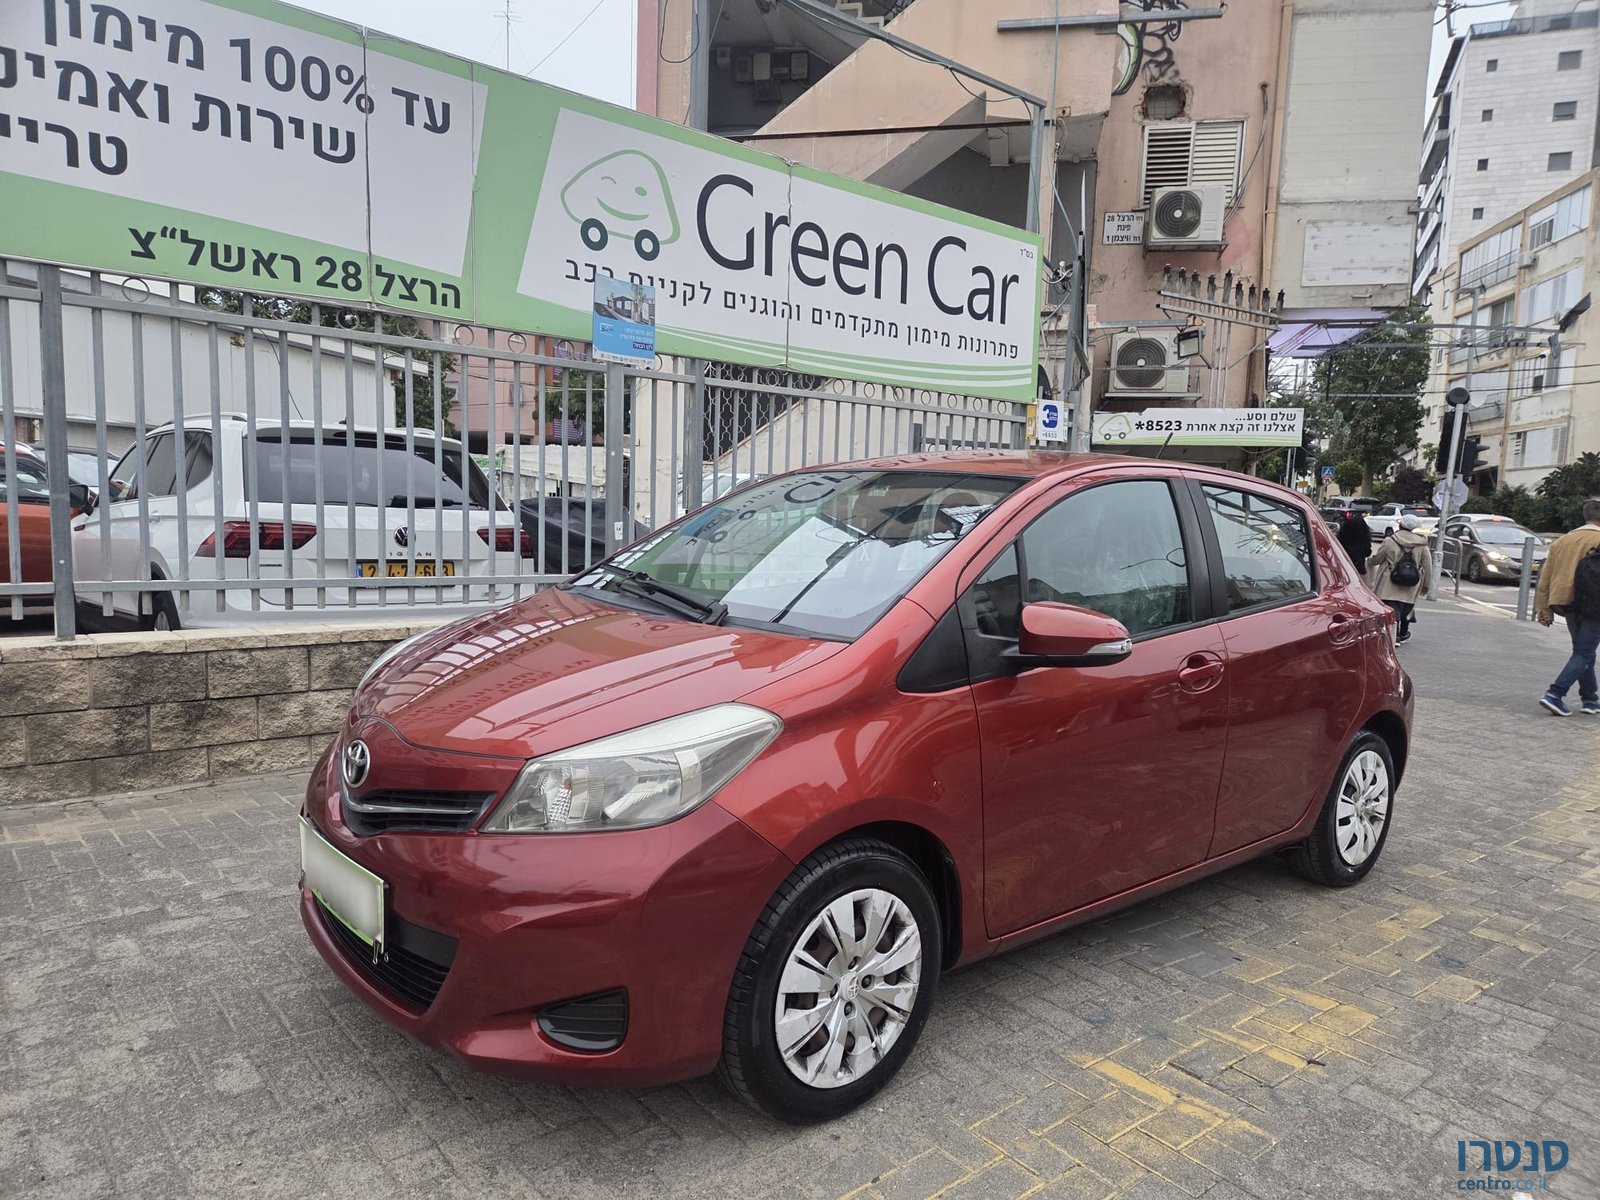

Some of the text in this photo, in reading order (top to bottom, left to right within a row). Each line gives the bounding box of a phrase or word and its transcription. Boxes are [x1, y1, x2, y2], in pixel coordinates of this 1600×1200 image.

[44, 0, 451, 135] עד 100% מימון
[192, 93, 356, 164] שירות
[697, 172, 1020, 325] Green Car
[128, 225, 461, 310] הרצל 28 ראשל"צ
[723, 290, 801, 323] והוגנים
[812, 307, 898, 341] מתקדמים
[908, 326, 951, 349] מימון
[957, 335, 1018, 359] פתרונות
[1186, 423, 1217, 432] אחרת
[1220, 423, 1244, 433] קצת
[1235, 411, 1297, 421] שלם וסע...
[1247, 423, 1260, 432] זה
[1263, 422, 1295, 432] אצלנו
